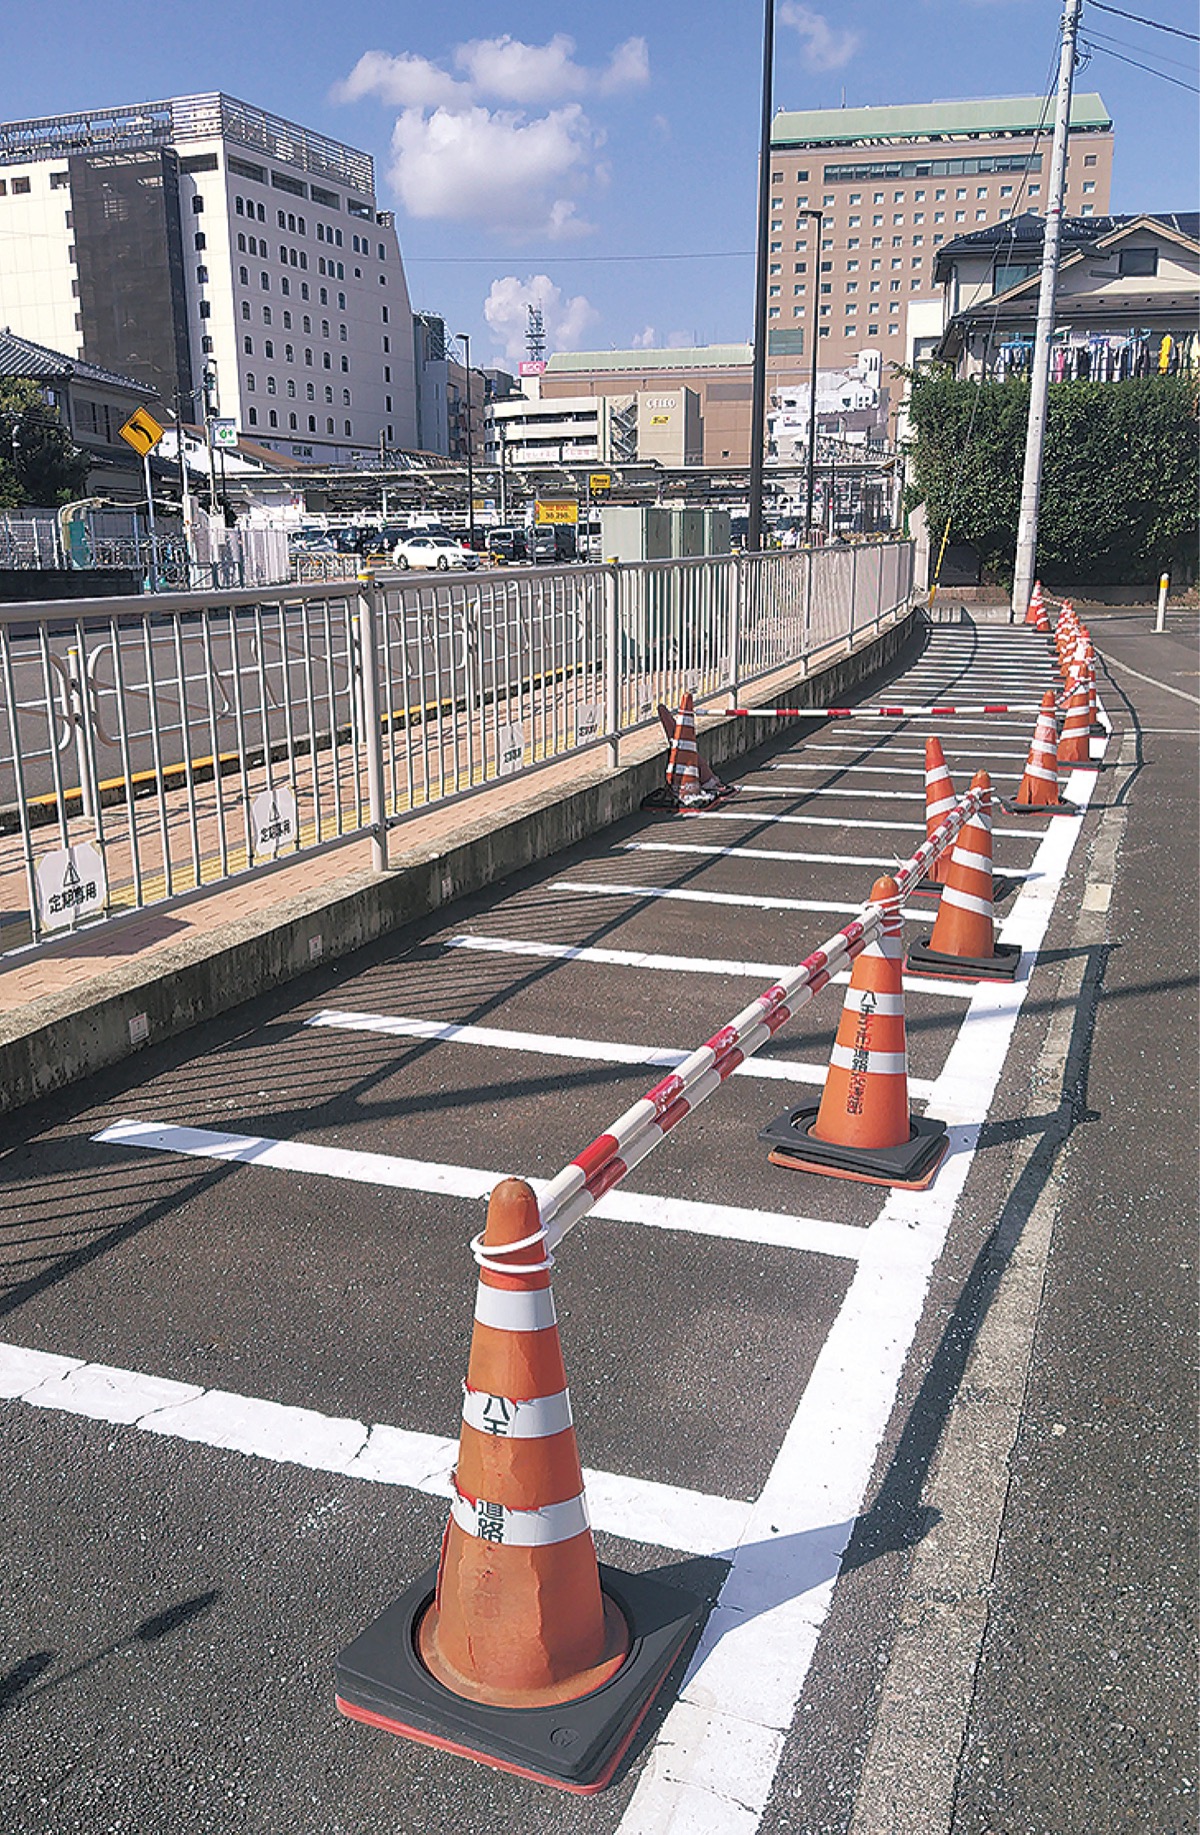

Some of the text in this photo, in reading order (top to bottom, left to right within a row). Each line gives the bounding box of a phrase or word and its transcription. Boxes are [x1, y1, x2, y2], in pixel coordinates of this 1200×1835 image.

[48, 881, 97, 914] 定期専用
[478, 1500, 505, 1543] 道路
